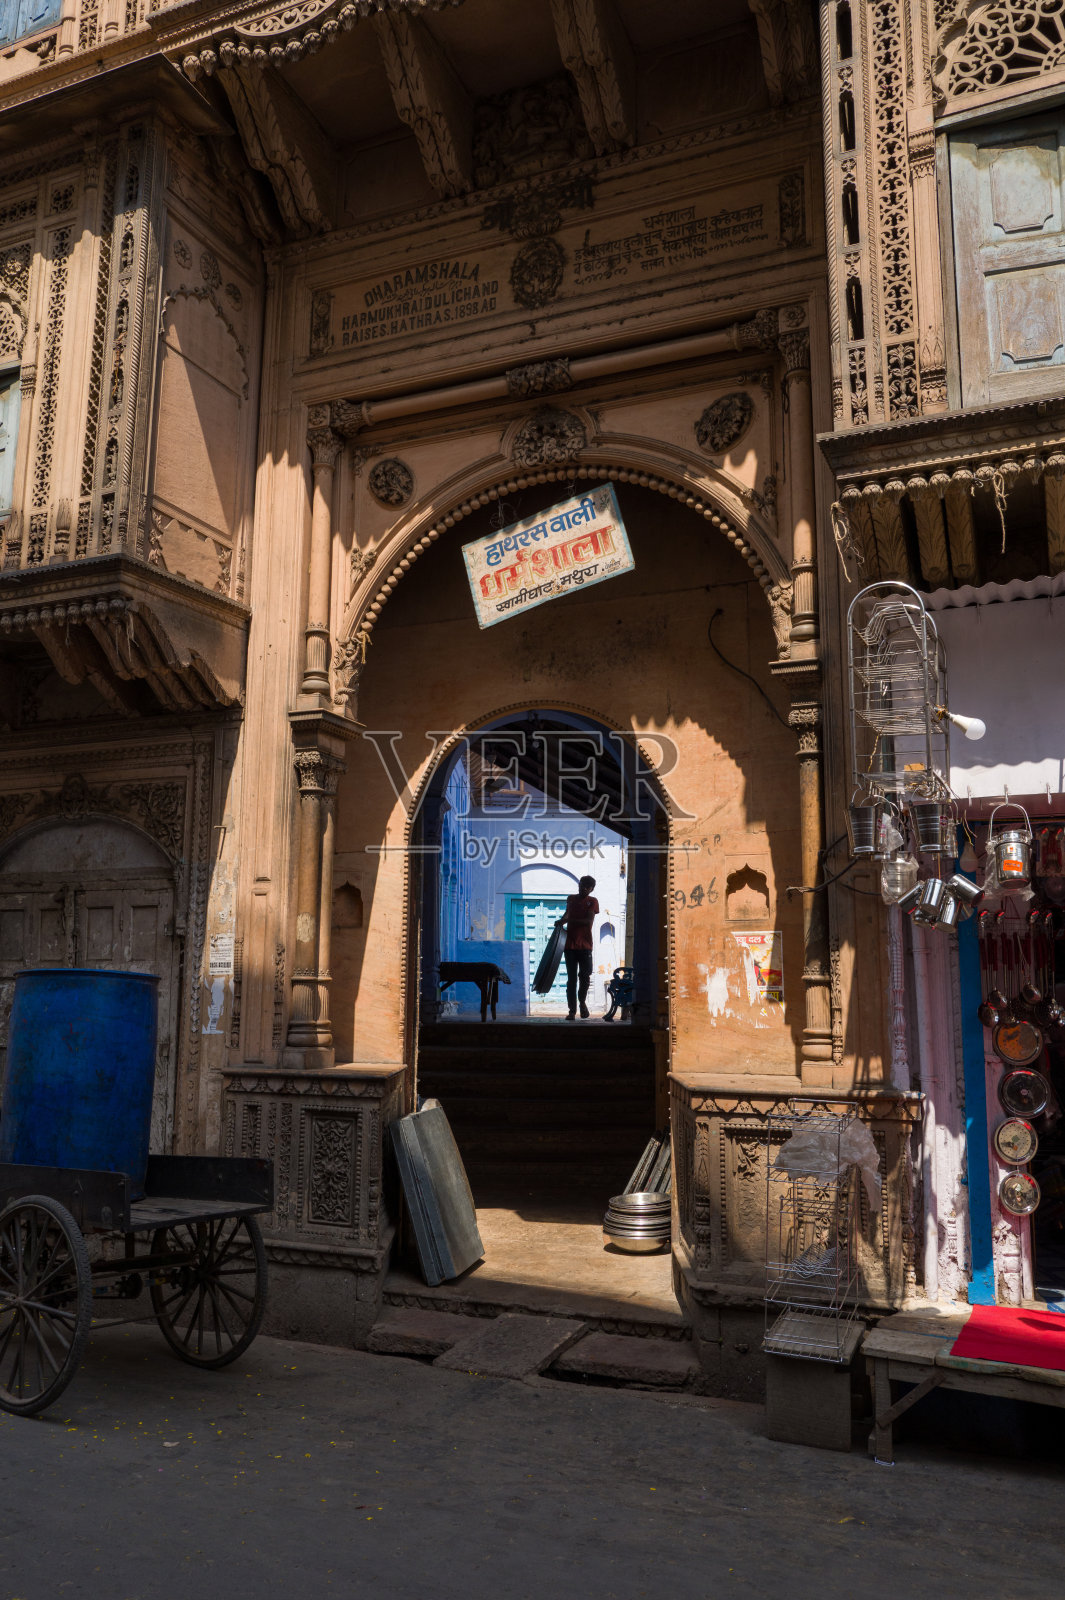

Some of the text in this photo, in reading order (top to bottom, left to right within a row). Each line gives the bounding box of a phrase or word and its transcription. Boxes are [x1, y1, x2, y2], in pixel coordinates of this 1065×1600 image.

[642, 205, 696, 229] धर्मशाला
[363, 261, 480, 308] DHARAMSHALA
[484, 497, 597, 567] हाथरस वाली
[479, 525, 614, 599] धर्मशाला
